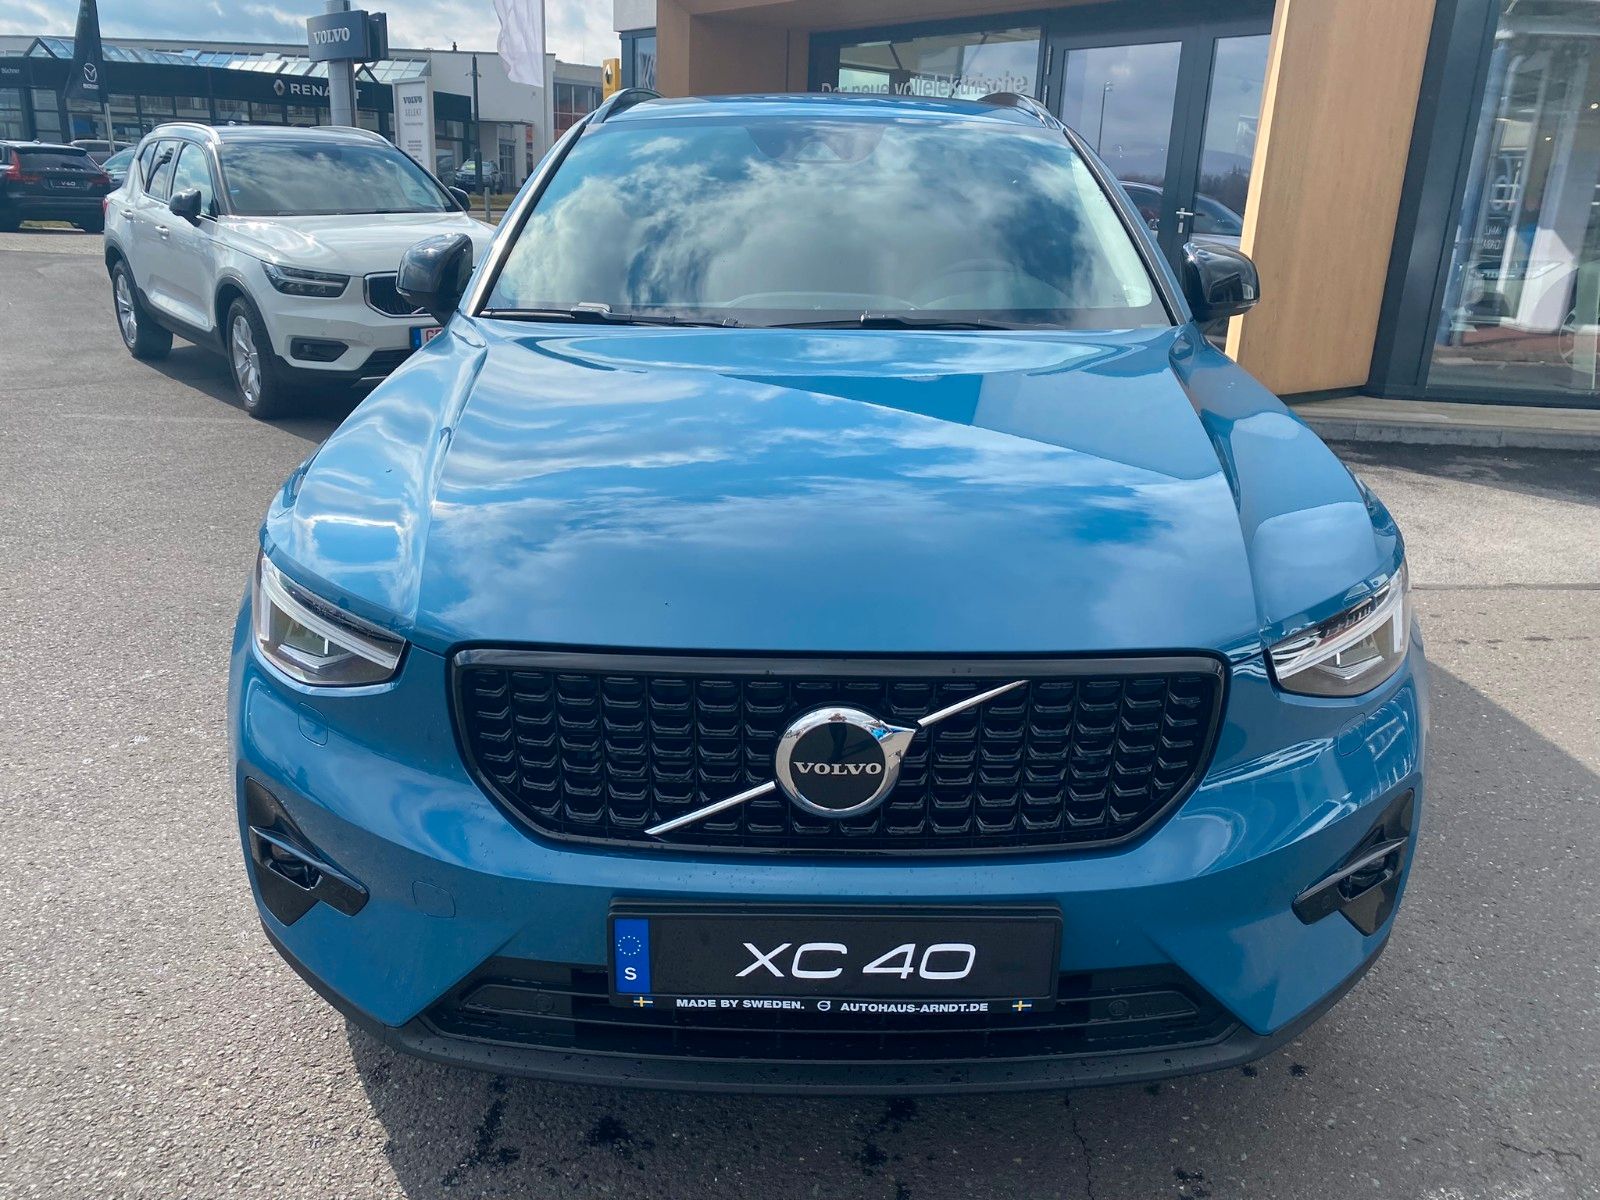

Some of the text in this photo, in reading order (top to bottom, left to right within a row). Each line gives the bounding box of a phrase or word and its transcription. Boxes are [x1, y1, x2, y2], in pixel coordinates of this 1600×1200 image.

[313, 27, 351, 45] VOLVO
[289, 83, 362, 100] RENT
[403, 95, 423, 105] VOLVO
[793, 761, 882, 775] VOLVO
[735, 942, 977, 980] XC 40
[624, 967, 637, 981] S
[676, 999, 805, 1010] MADE BY SWEDEN.
[840, 1002, 989, 1013] AUTOHAUS-ARNDT.DE
